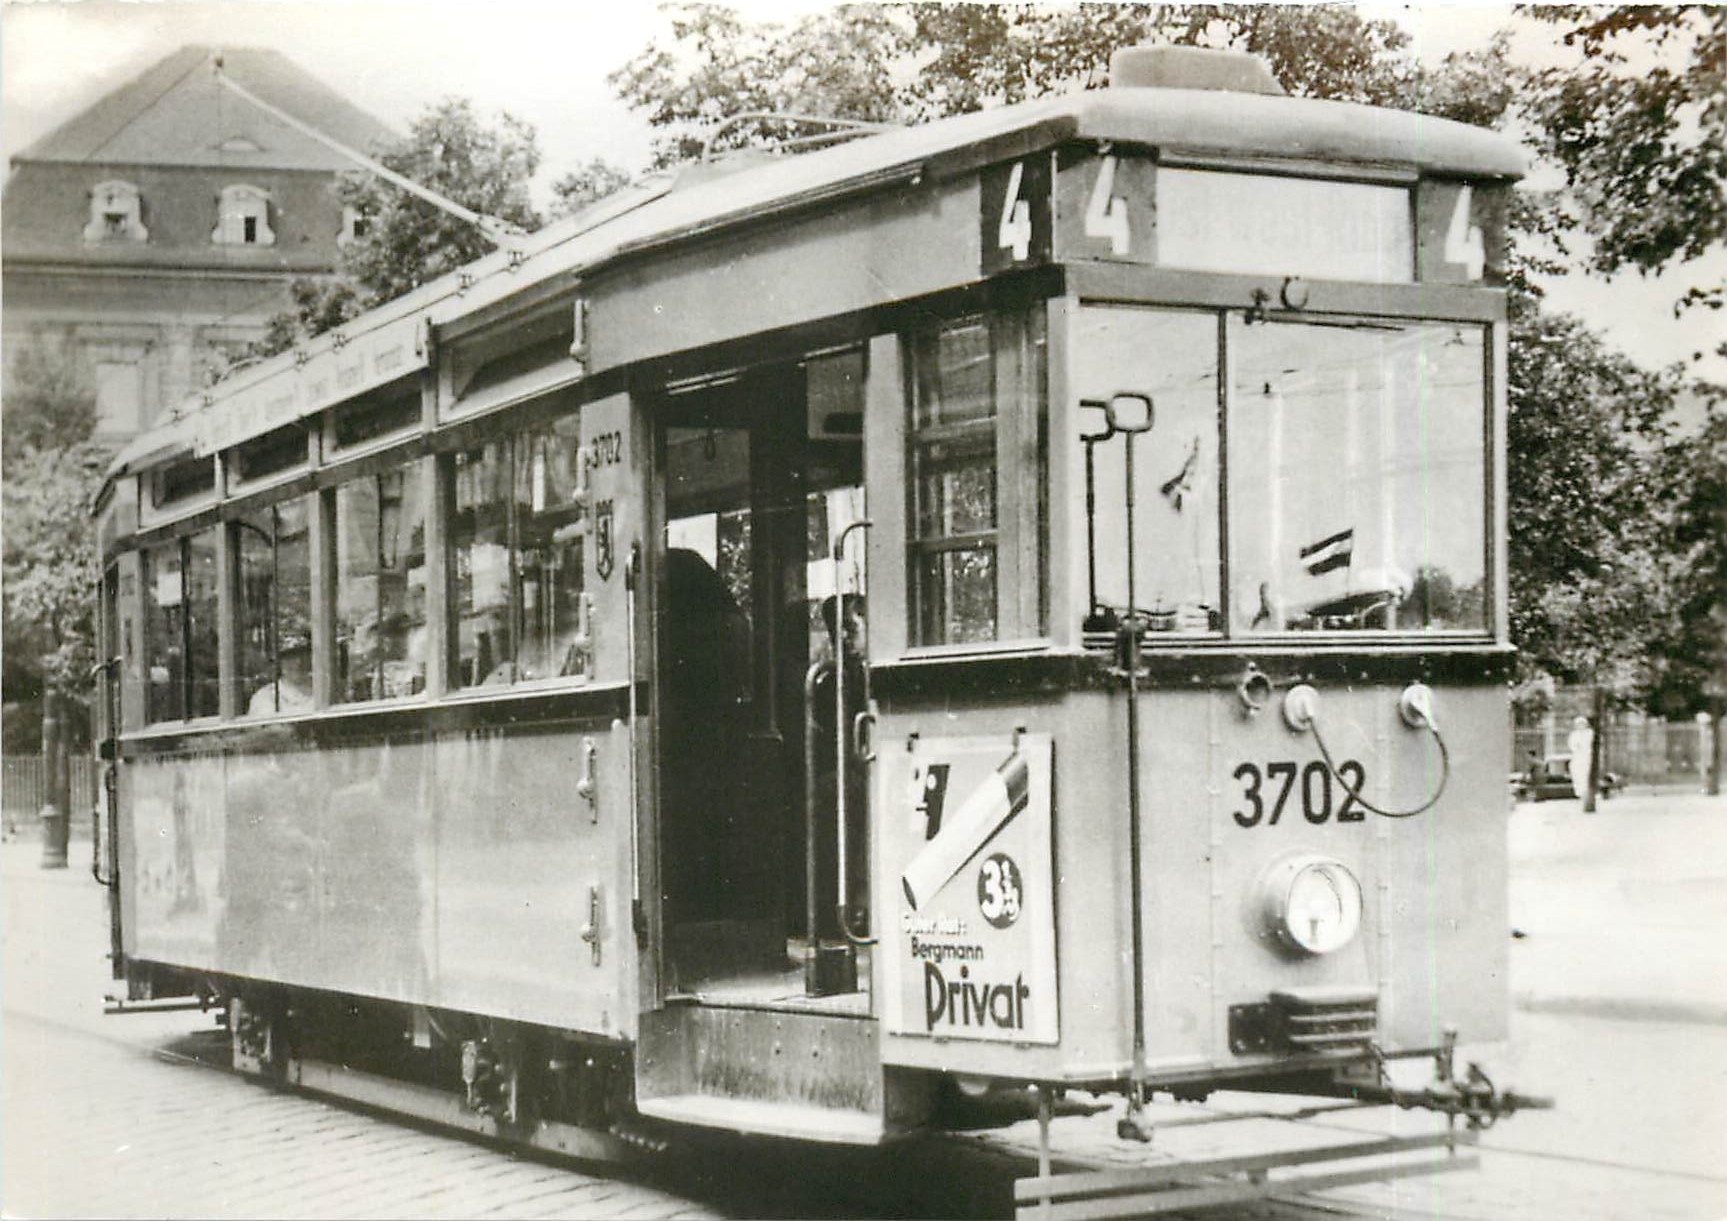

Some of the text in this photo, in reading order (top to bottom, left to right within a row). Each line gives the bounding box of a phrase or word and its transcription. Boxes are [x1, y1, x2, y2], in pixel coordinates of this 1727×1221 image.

[1000, 162, 1030, 261] 4
[1085, 155, 1129, 255] 4
[1445, 182, 1485, 281] 4
[591, 430, 622, 468] 3702
[1233, 760, 1366, 828] 3702
[911, 937, 984, 964] Bergmann
[924, 961, 1030, 1031] Privat
